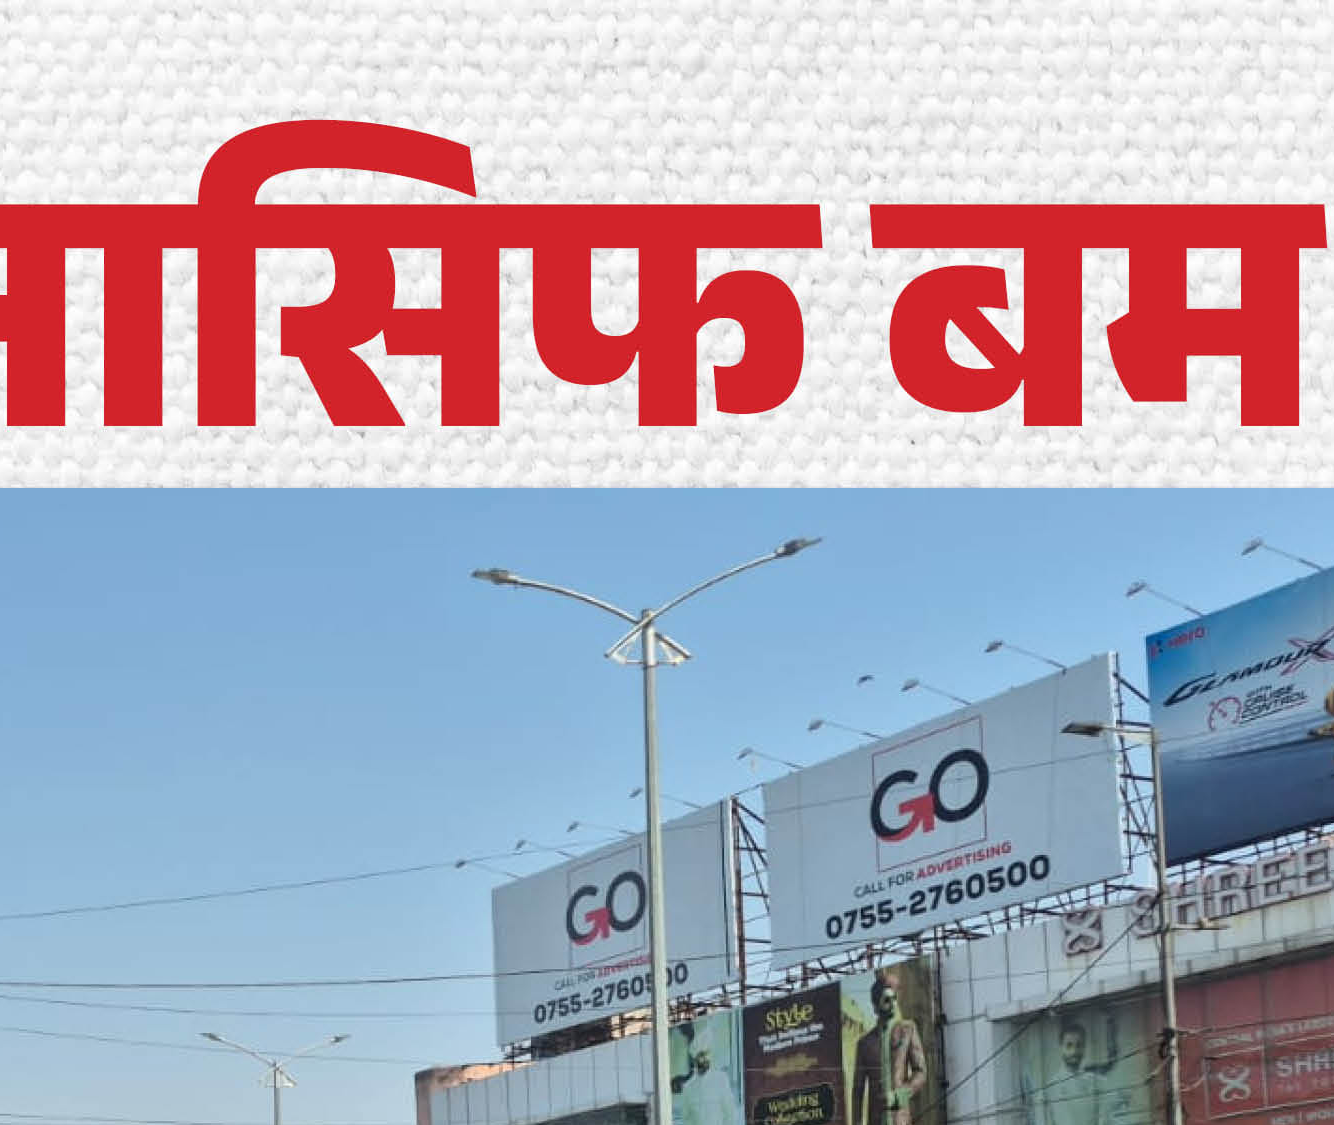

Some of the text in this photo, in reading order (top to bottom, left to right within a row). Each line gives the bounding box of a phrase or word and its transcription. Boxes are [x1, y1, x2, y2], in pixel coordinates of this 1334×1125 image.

[870, 748, 989, 843] GO
[825, 855, 1051, 940] 0755-2760500
[854, 840, 1012, 899] CALL FOR ADVERTISING
[566, 871, 646, 946] GO
[765, 1003, 814, 1032] Style
